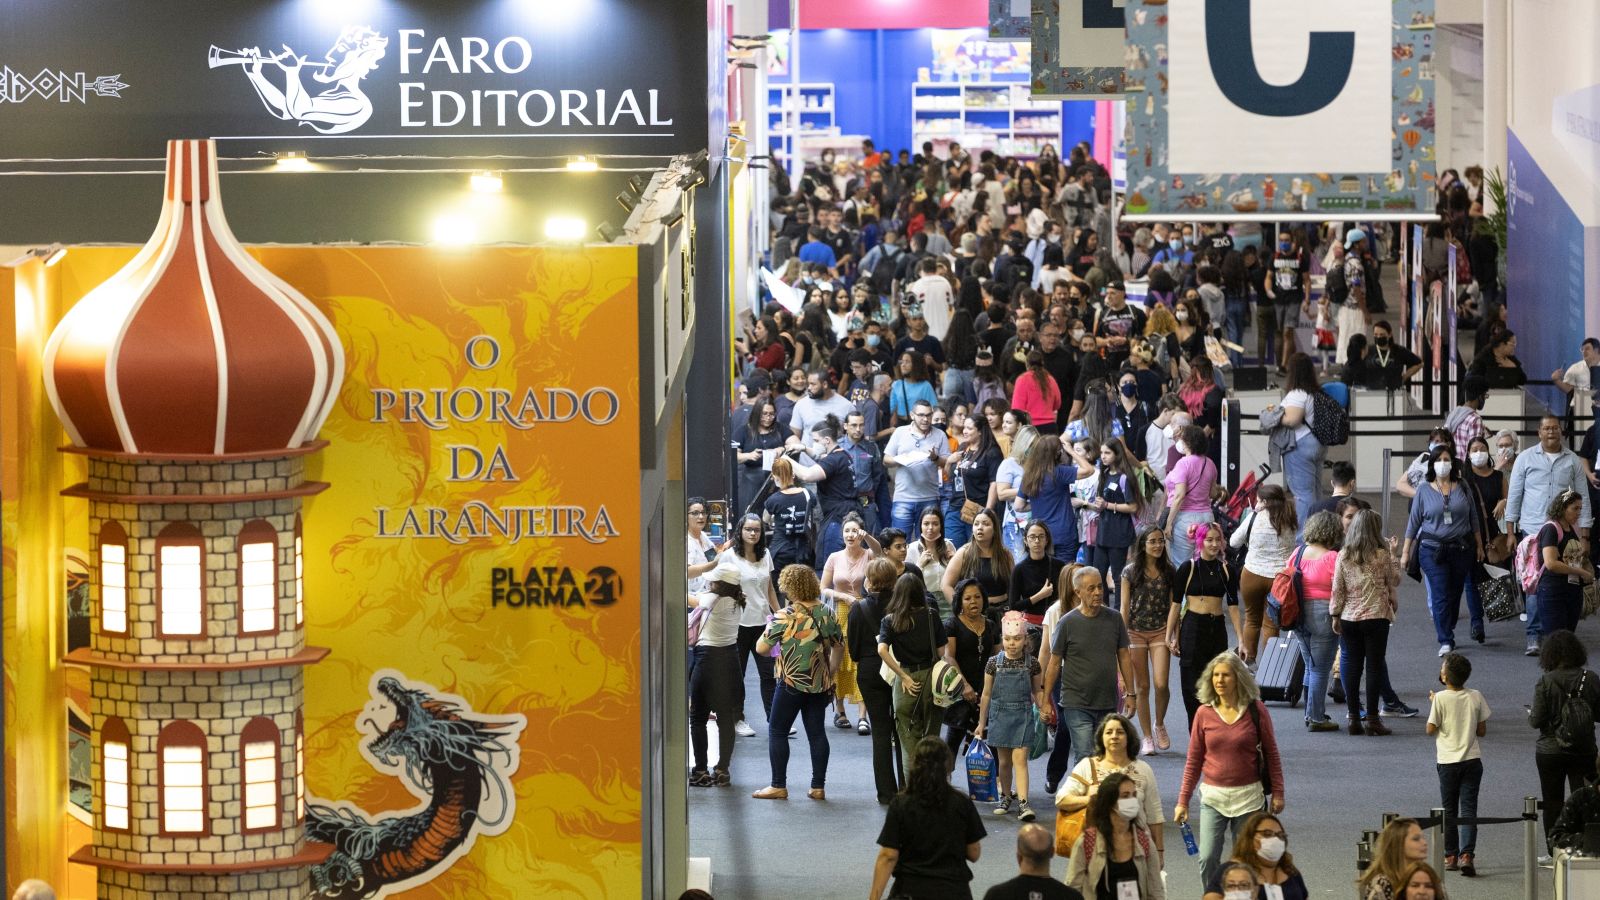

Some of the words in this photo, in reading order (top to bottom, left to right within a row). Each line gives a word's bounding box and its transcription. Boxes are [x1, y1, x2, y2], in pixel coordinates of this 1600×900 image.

[398, 28, 532, 74] FARO
[0, 65, 86, 104] IDON
[399, 82, 673, 127] EDITORIAL
[465, 335, 500, 369] O
[370, 386, 620, 430] PRIORADO
[446, 443, 519, 482] DA
[373, 500, 620, 545] LARANJEIRA
[491, 566, 577, 587] PLATA
[584, 570, 621, 603] 21
[491, 587, 586, 609] FORMA
